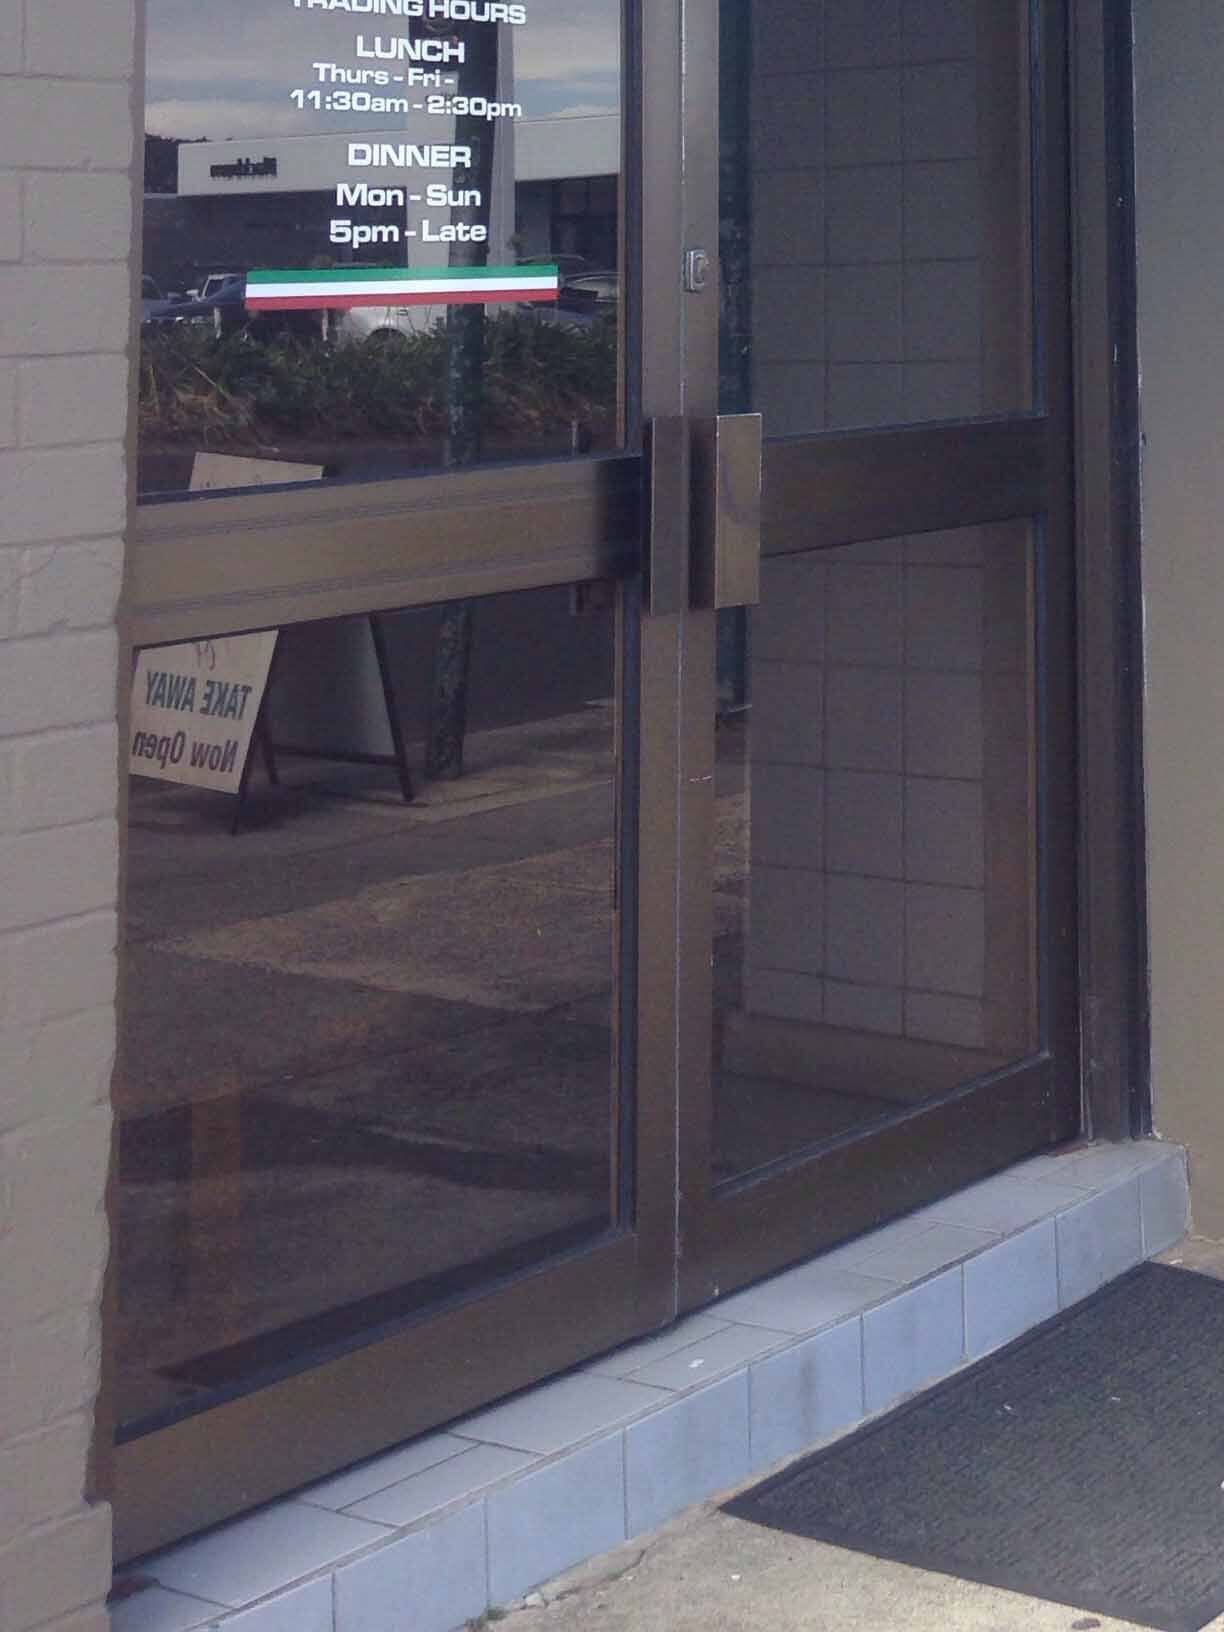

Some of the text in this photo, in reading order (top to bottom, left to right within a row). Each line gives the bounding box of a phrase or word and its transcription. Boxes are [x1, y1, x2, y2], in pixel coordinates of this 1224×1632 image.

[356, 36, 465, 63] LUNCH
[313, 63, 389, 87] Thurs
[408, 69, 441, 87] Fri
[289, 89, 408, 113] 11:30am
[426, 97, 522, 120] 2:30pm
[348, 143, 471, 168] DINNER
[336, 184, 404, 206] Mon
[426, 184, 481, 206] Sun
[330, 220, 398, 248] 5pm
[422, 220, 487, 242] Late
